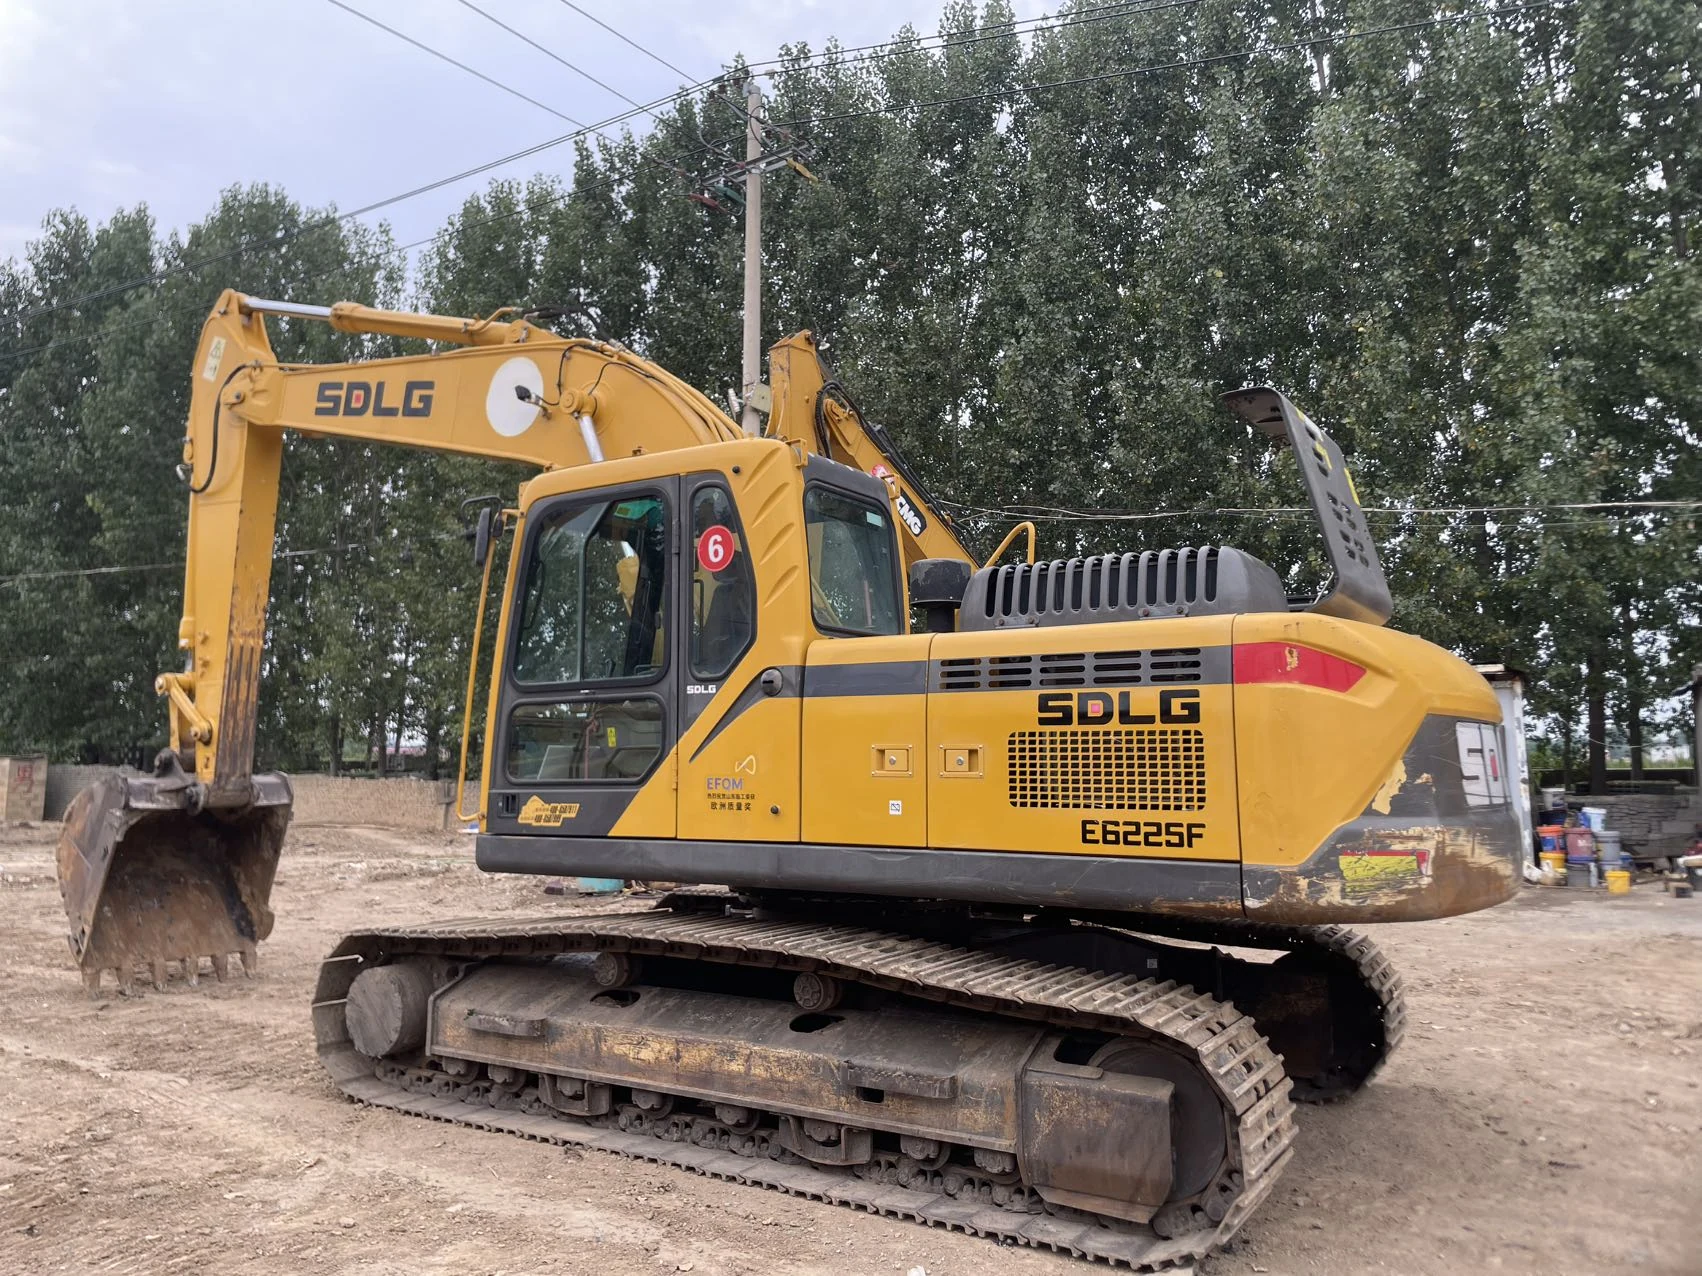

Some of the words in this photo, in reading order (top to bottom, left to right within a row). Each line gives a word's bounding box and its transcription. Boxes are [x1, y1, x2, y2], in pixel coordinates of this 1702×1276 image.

[315, 381, 435, 417] SDLG
[893, 488, 922, 535] CMG
[707, 534, 724, 563] 6
[687, 685, 717, 694] SDLG
[1037, 689, 1201, 726] SDLG
[706, 777, 743, 791] EFQM
[710, 802, 752, 811] 欧洲质量奖
[1081, 819, 1206, 848] E6225F
